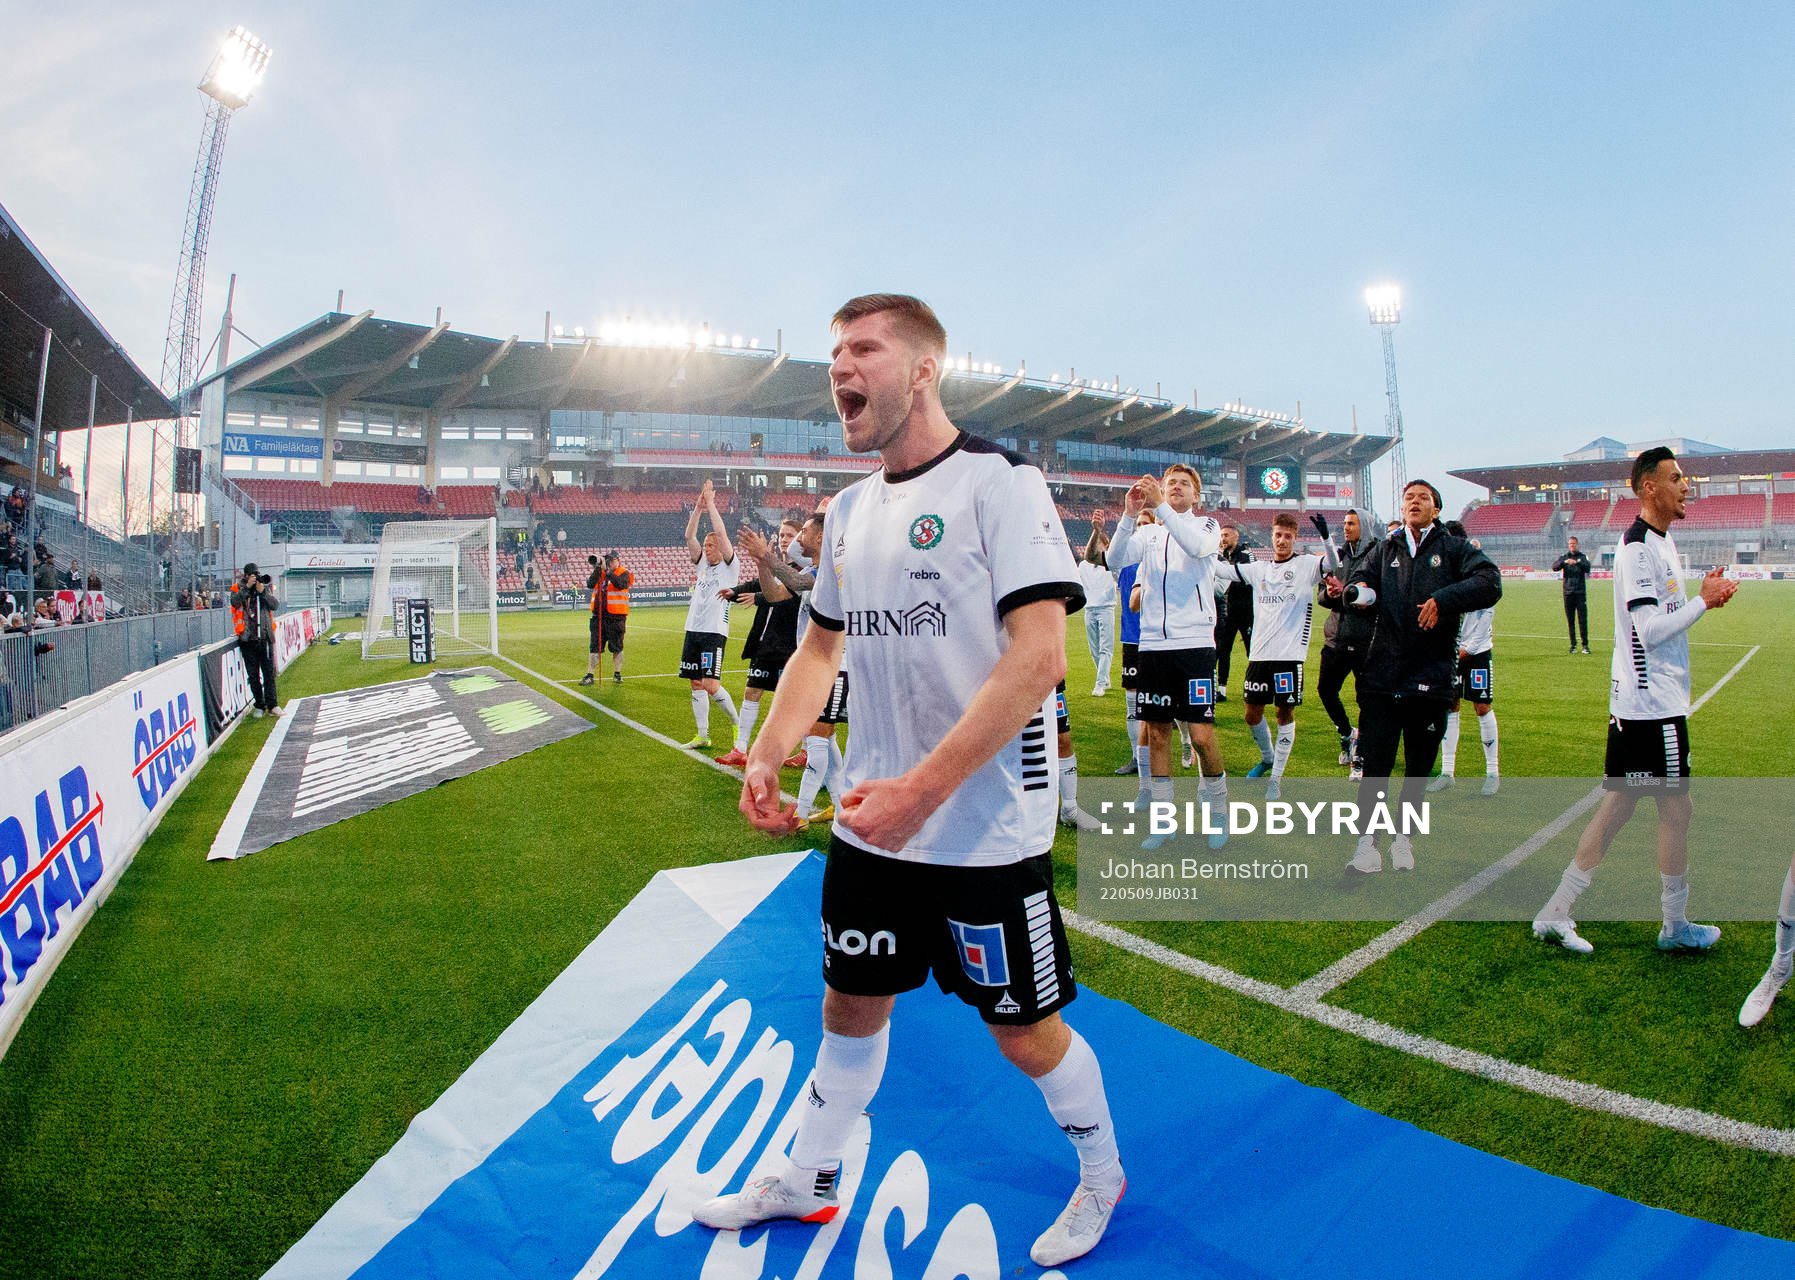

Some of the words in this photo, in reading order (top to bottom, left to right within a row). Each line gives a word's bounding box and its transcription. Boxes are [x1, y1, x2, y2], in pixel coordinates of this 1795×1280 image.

[224, 436, 249, 452] NA
[254, 440, 319, 454] Familjeläktare
[305, 556, 346, 567] Lindells
[1501, 567, 1527, 576] candic
[411, 607, 427, 663] SELECT
[1626, 778, 1661, 787] ELLNESS
[0, 765, 104, 1000] BAB
[995, 1006, 1021, 1014] SELECT
